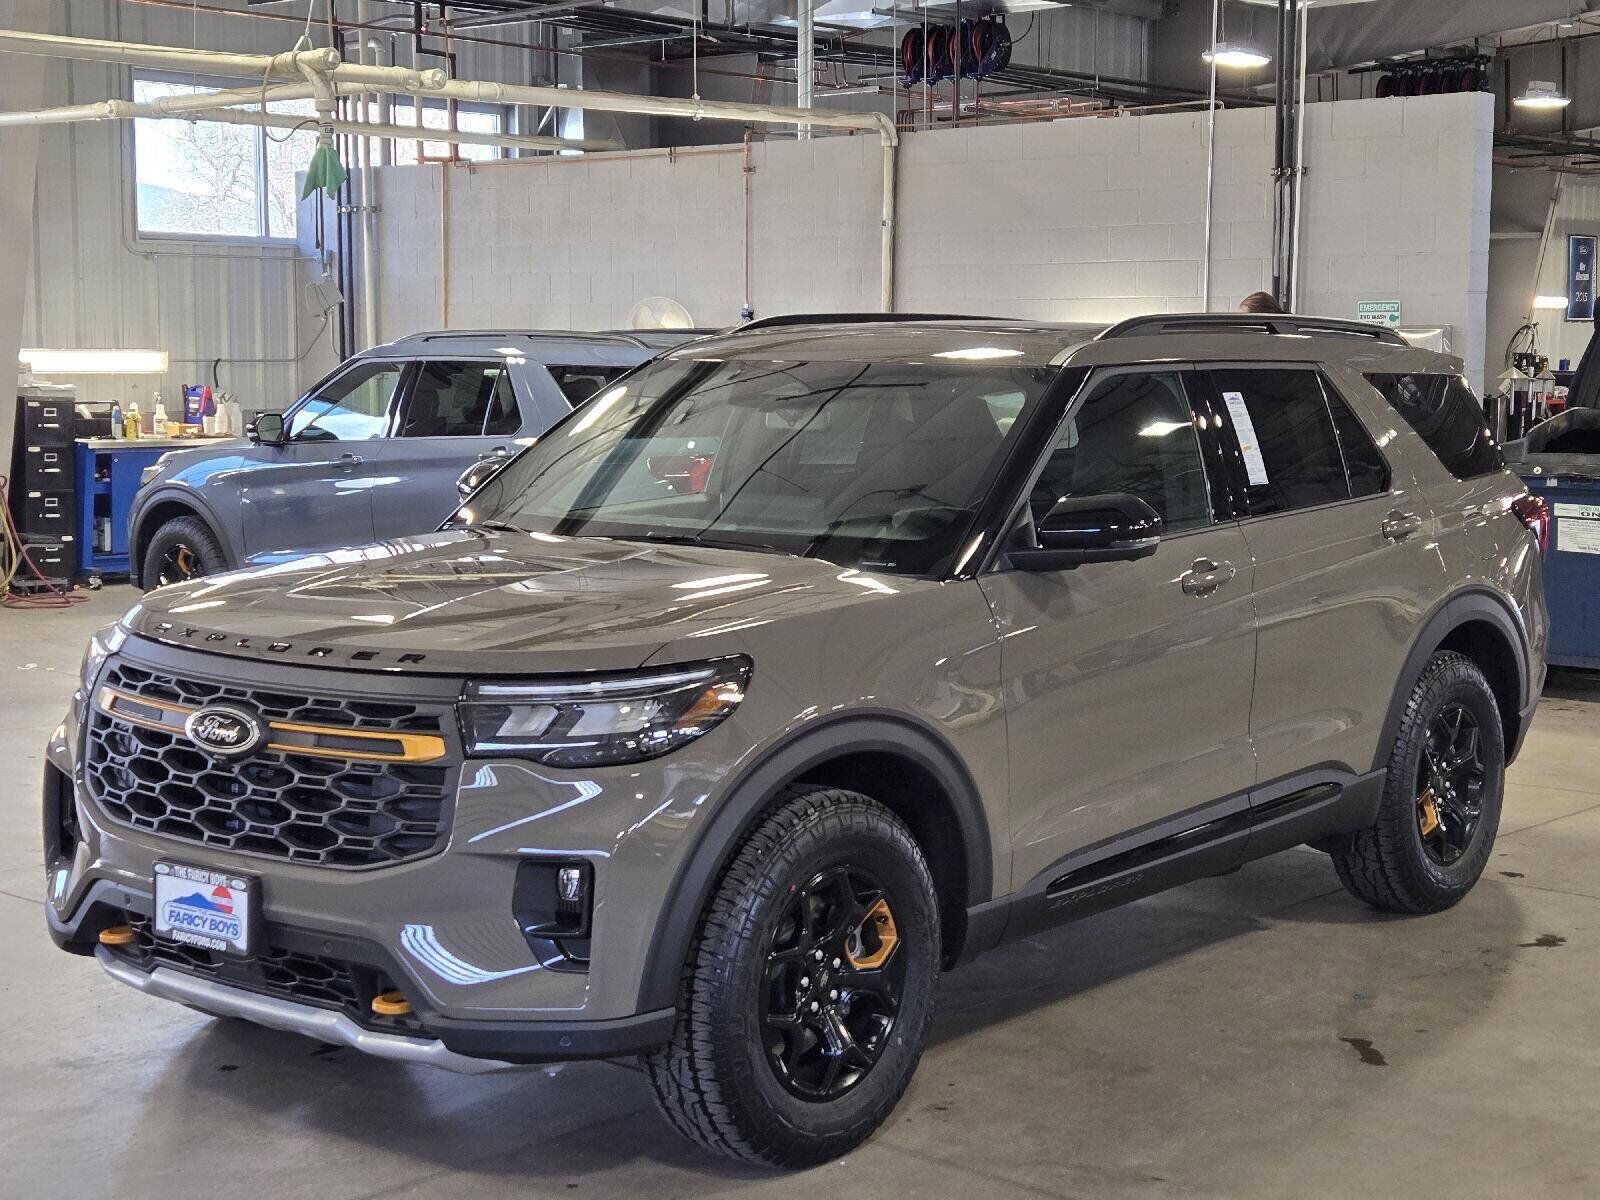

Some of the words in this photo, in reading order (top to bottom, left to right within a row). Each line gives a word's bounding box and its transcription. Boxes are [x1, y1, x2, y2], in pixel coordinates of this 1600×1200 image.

[1360, 303, 1398, 311] EMERGENCY
[154, 621, 427, 664] EXPLORER
[194, 715, 241, 743] Ford
[168, 909, 208, 928] FARICY
[209, 917, 239, 937] BOYS
